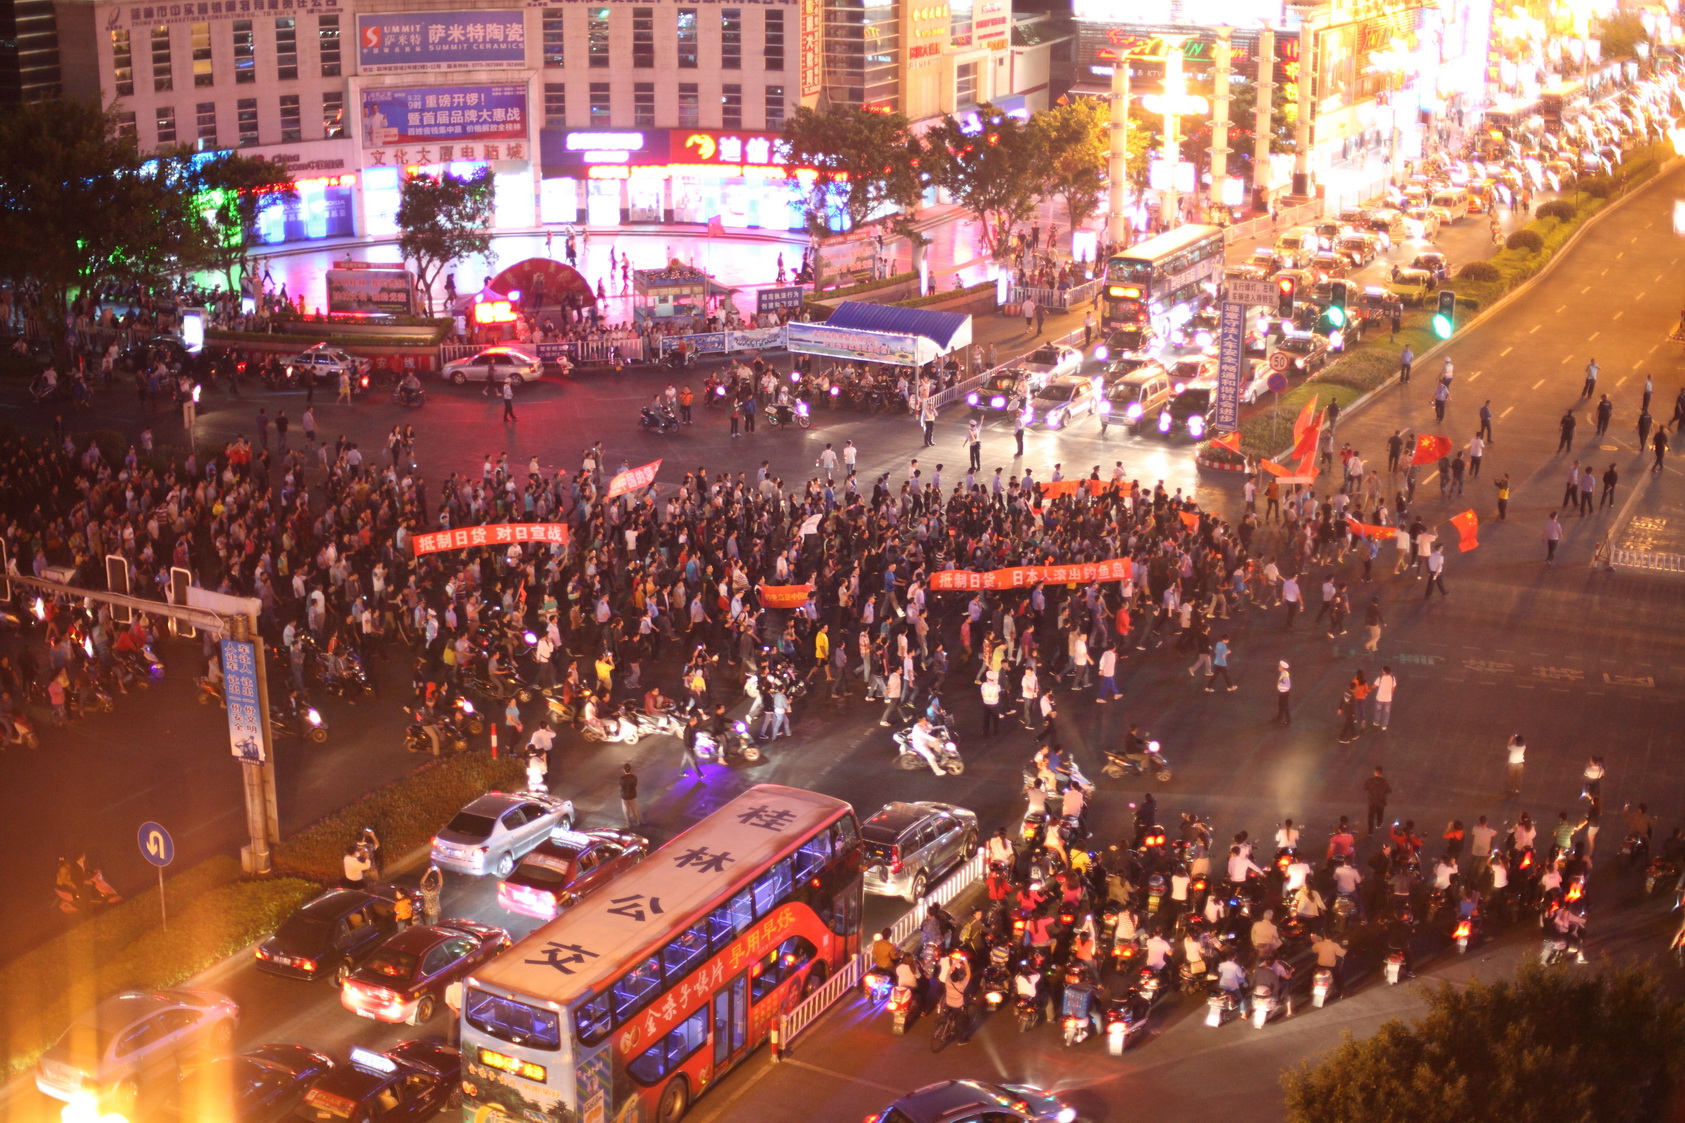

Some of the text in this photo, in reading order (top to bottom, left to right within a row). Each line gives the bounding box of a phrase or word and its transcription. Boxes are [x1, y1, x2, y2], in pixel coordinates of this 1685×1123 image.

[384, 34, 421, 46] 萨米特
[428, 23, 524, 44] 萨米特陶瓷
[473, 42, 524, 50] CERAMICS
[407, 107, 521, 126] 暨首届品牌大惠战
[370, 143, 524, 166] 文化大厦电脑城
[1274, 356, 1285, 368] 50
[418, 525, 563, 552] 抵制日货 对日宣战
[1012, 561, 1126, 585] 日本人滚出钓鱼岛
[224, 642, 243, 732] 人让车 让出一份安全
[237, 644, 258, 734] 车让人 让出一份文明
[524, 805, 798, 975] 桂林公交
